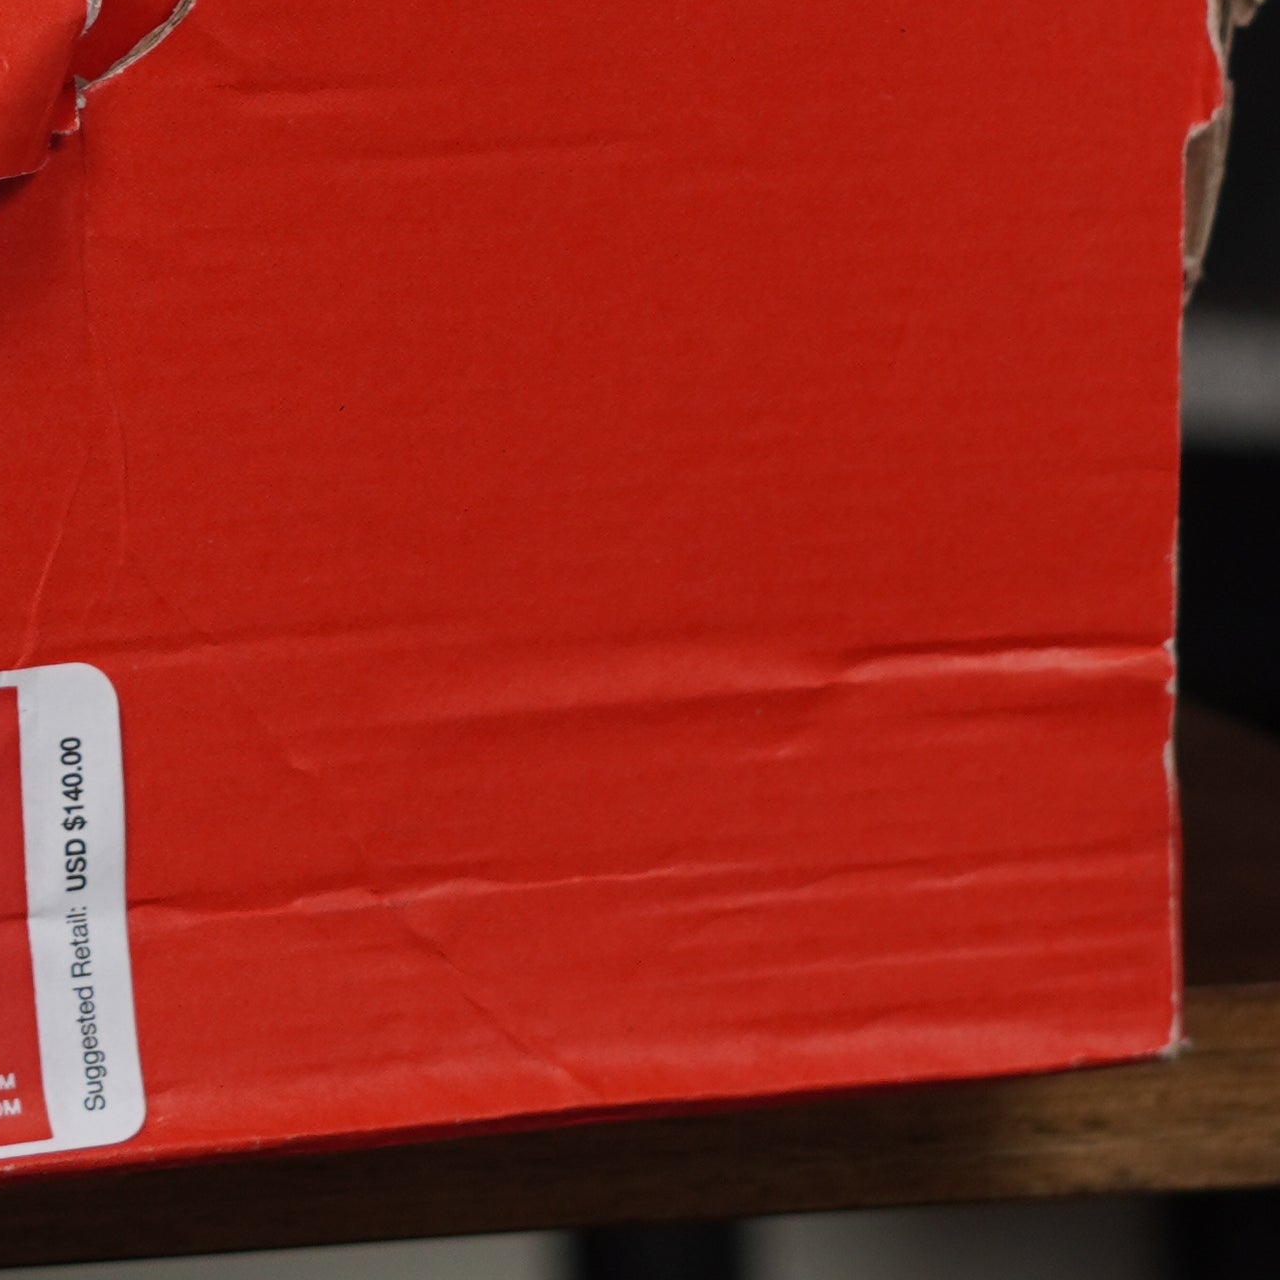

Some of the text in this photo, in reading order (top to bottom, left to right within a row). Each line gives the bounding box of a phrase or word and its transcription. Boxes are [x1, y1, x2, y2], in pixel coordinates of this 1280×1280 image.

[60, 736, 107, 1112] Suggested Retail: USD $140.00
